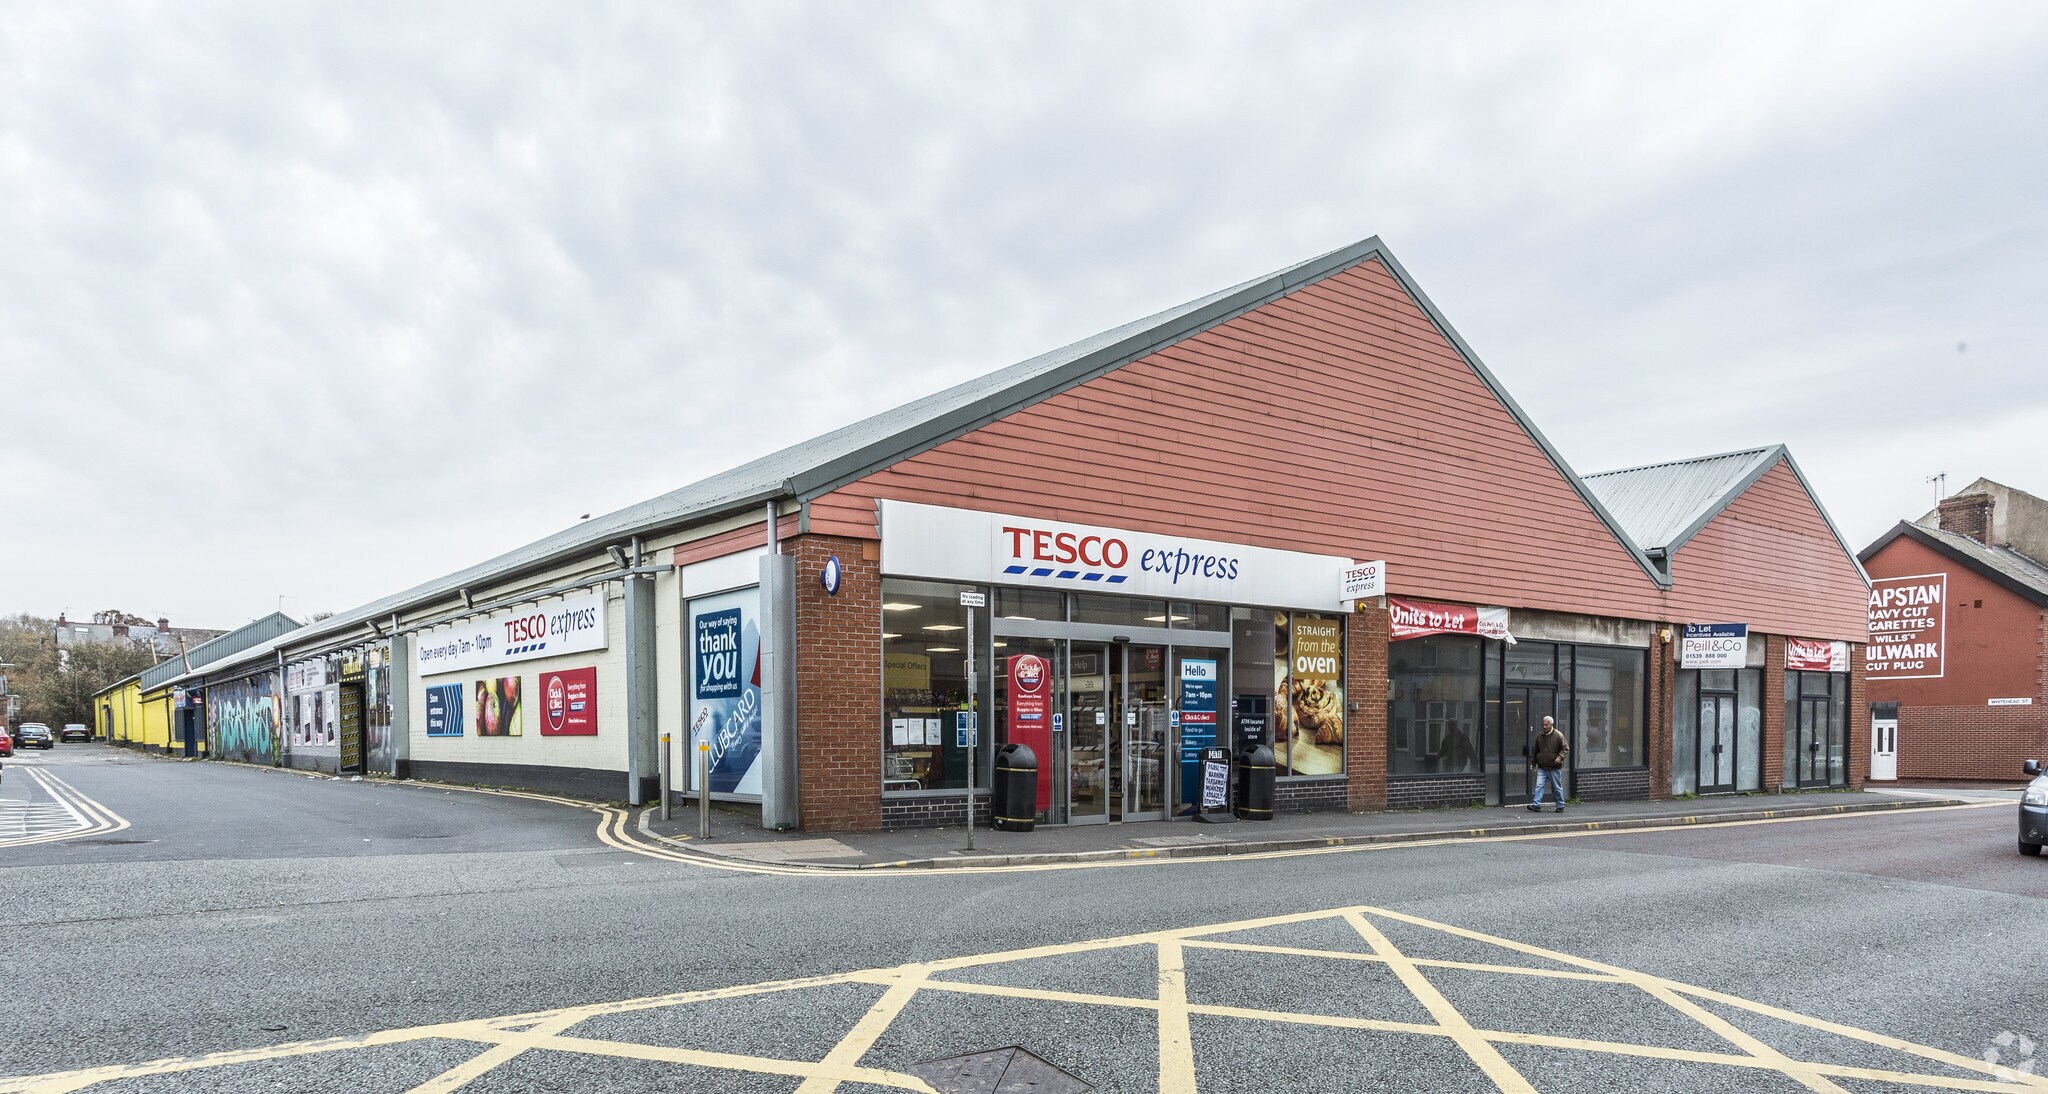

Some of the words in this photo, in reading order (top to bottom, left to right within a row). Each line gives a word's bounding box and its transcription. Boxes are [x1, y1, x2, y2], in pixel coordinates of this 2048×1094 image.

[1003, 526, 1128, 569] TESCO
[1141, 546, 1239, 584] express
[1346, 566, 1376, 578] TESCO
[1346, 582, 1375, 593] express
[1869, 584, 1940, 608] APSTAN
[1390, 605, 1425, 626] Units
[1429, 610, 1441, 628] to
[1444, 611, 1464, 629] Let
[1903, 606, 1929, 617] CUT
[505, 613, 546, 644] TESCO
[551, 606, 595, 641] express
[700, 620, 708, 629] Our
[708, 620, 717, 629] way
[718, 617, 723, 626] of
[723, 616, 737, 627] saying
[1869, 618, 1935, 631] GARETTES
[1297, 625, 1336, 637] STRAIGHT
[700, 626, 737, 653] thank
[1297, 638, 1318, 654] from
[1321, 639, 1335, 653] the
[420, 647, 433, 662] Open
[434, 646, 447, 660] every
[448, 641, 458, 659] day
[458, 639, 470, 654] 7am
[476, 634, 492, 653] 10pm
[1789, 643, 1806, 657] Units
[1807, 646, 1813, 657] to
[1815, 646, 1825, 658] Let
[1866, 643, 1938, 660] ULWARK
[702, 651, 737, 685] you
[884, 659, 906, 671] Special
[907, 662, 926, 671] Offers
[1074, 661, 1088, 670] Help
[1185, 665, 1206, 676] Hello
[1297, 656, 1336, 673] oven
[1865, 662, 1889, 671] CUT
[1893, 661, 1924, 670] PLUG
[705, 683, 723, 692] shopping
[724, 682, 732, 690] with
[430, 694, 438, 703] Store
[430, 707, 443, 715] entrance
[692, 707, 708, 734] TESCO
[709, 688, 755, 773] LUBCARD
[1208, 750, 1222, 758] Mail
